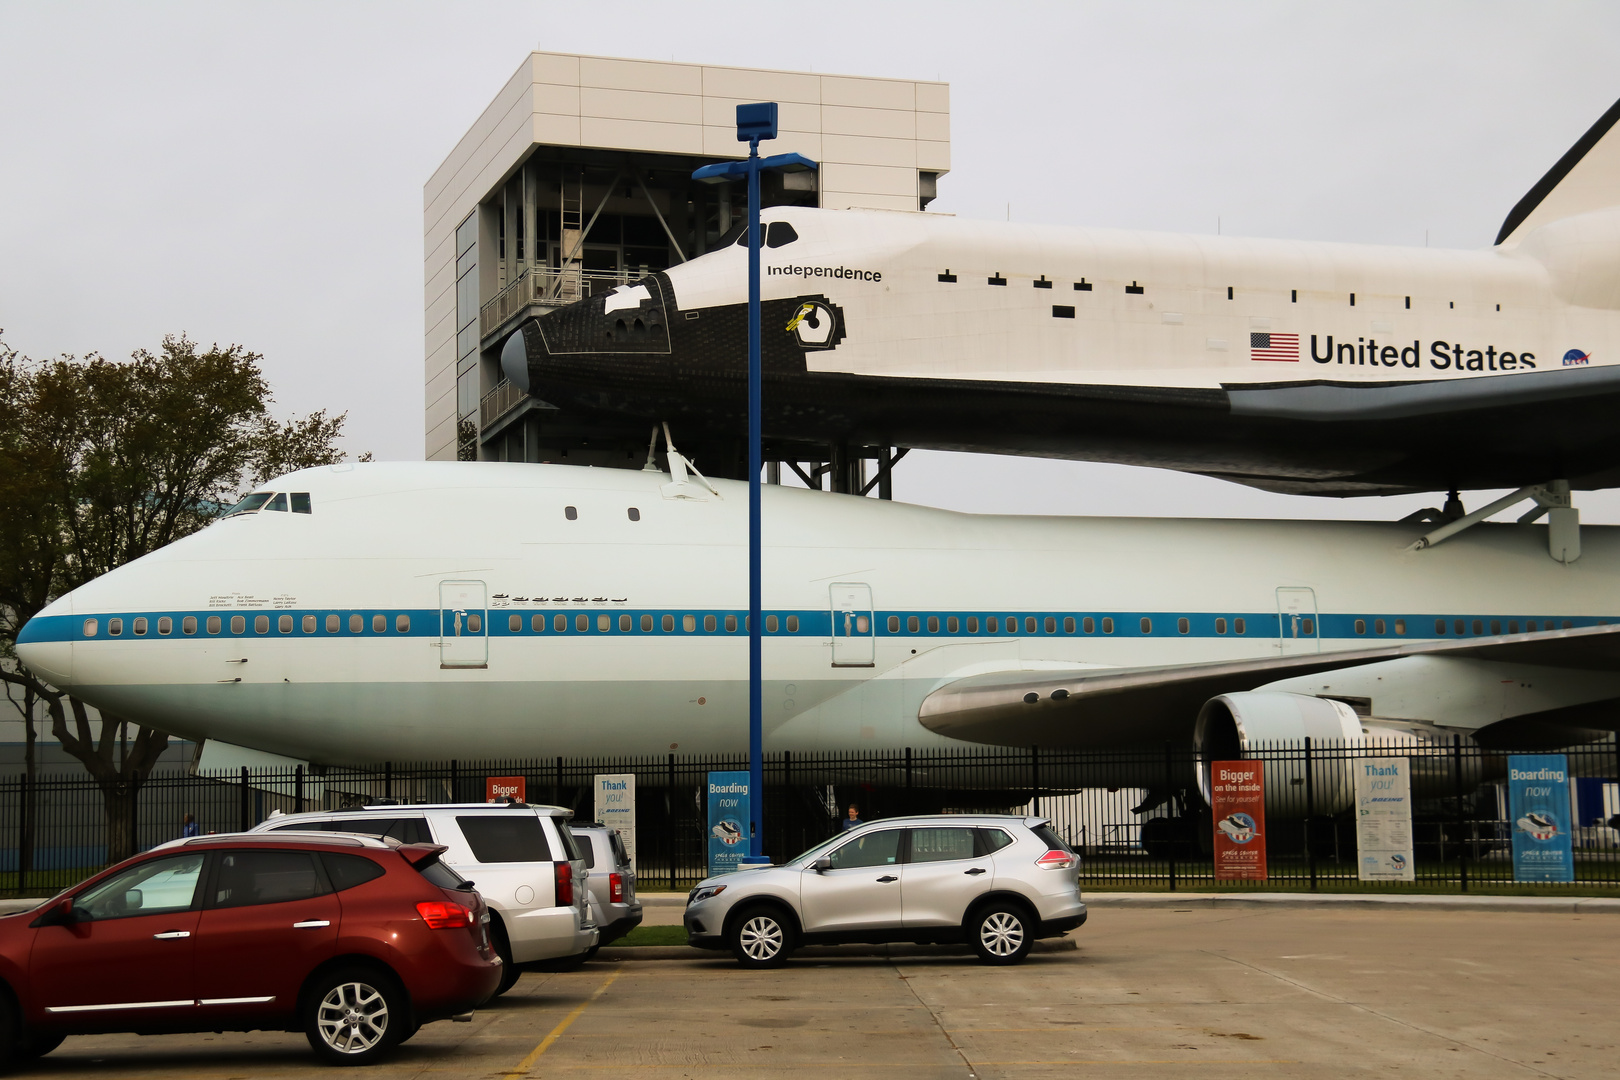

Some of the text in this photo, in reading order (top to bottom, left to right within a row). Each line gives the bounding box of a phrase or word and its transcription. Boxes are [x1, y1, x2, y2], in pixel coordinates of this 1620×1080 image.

[767, 264, 882, 282] Independence
[1310, 334, 1537, 371] United States
[1220, 769, 1254, 783] Bigger
[1364, 764, 1398, 776] Thank
[1511, 768, 1564, 782] Boarding
[492, 784, 518, 797] Bigger
[602, 780, 627, 790] Thank
[710, 782, 748, 796] Boarding
[1225, 783, 1237, 792] the
[1238, 783, 1260, 792] inside
[1370, 778, 1394, 792] you!
[1525, 786, 1551, 796] now
[606, 792, 624, 804] you!
[719, 798, 738, 807] now
[1236, 795, 1260, 804] yourself
